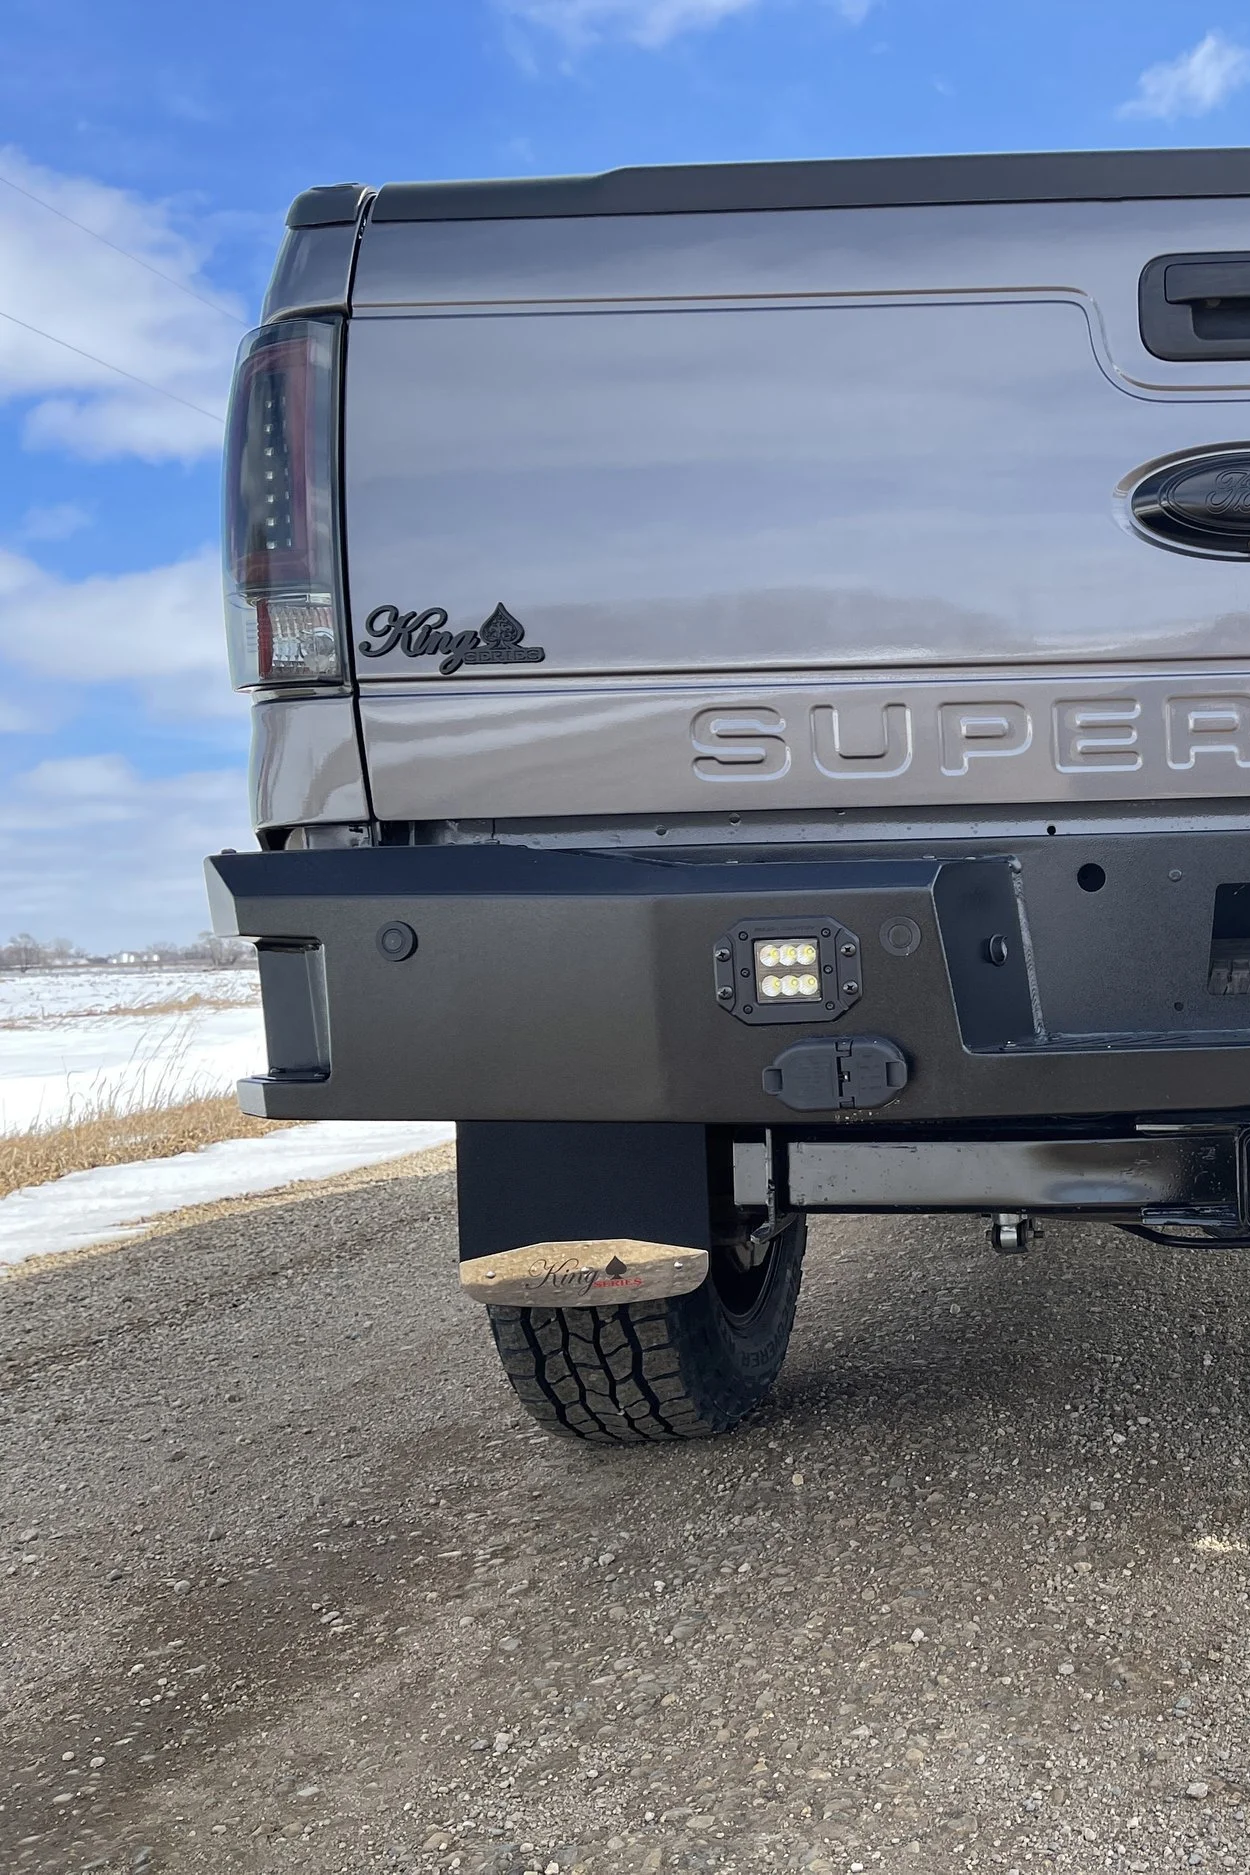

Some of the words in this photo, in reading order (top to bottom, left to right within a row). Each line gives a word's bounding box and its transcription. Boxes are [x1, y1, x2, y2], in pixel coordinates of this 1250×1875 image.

[358, 604, 481, 676] King
[465, 650, 540, 663] SERIES
[525, 1257, 601, 1297] King
[592, 1277, 643, 1289] SERIES
